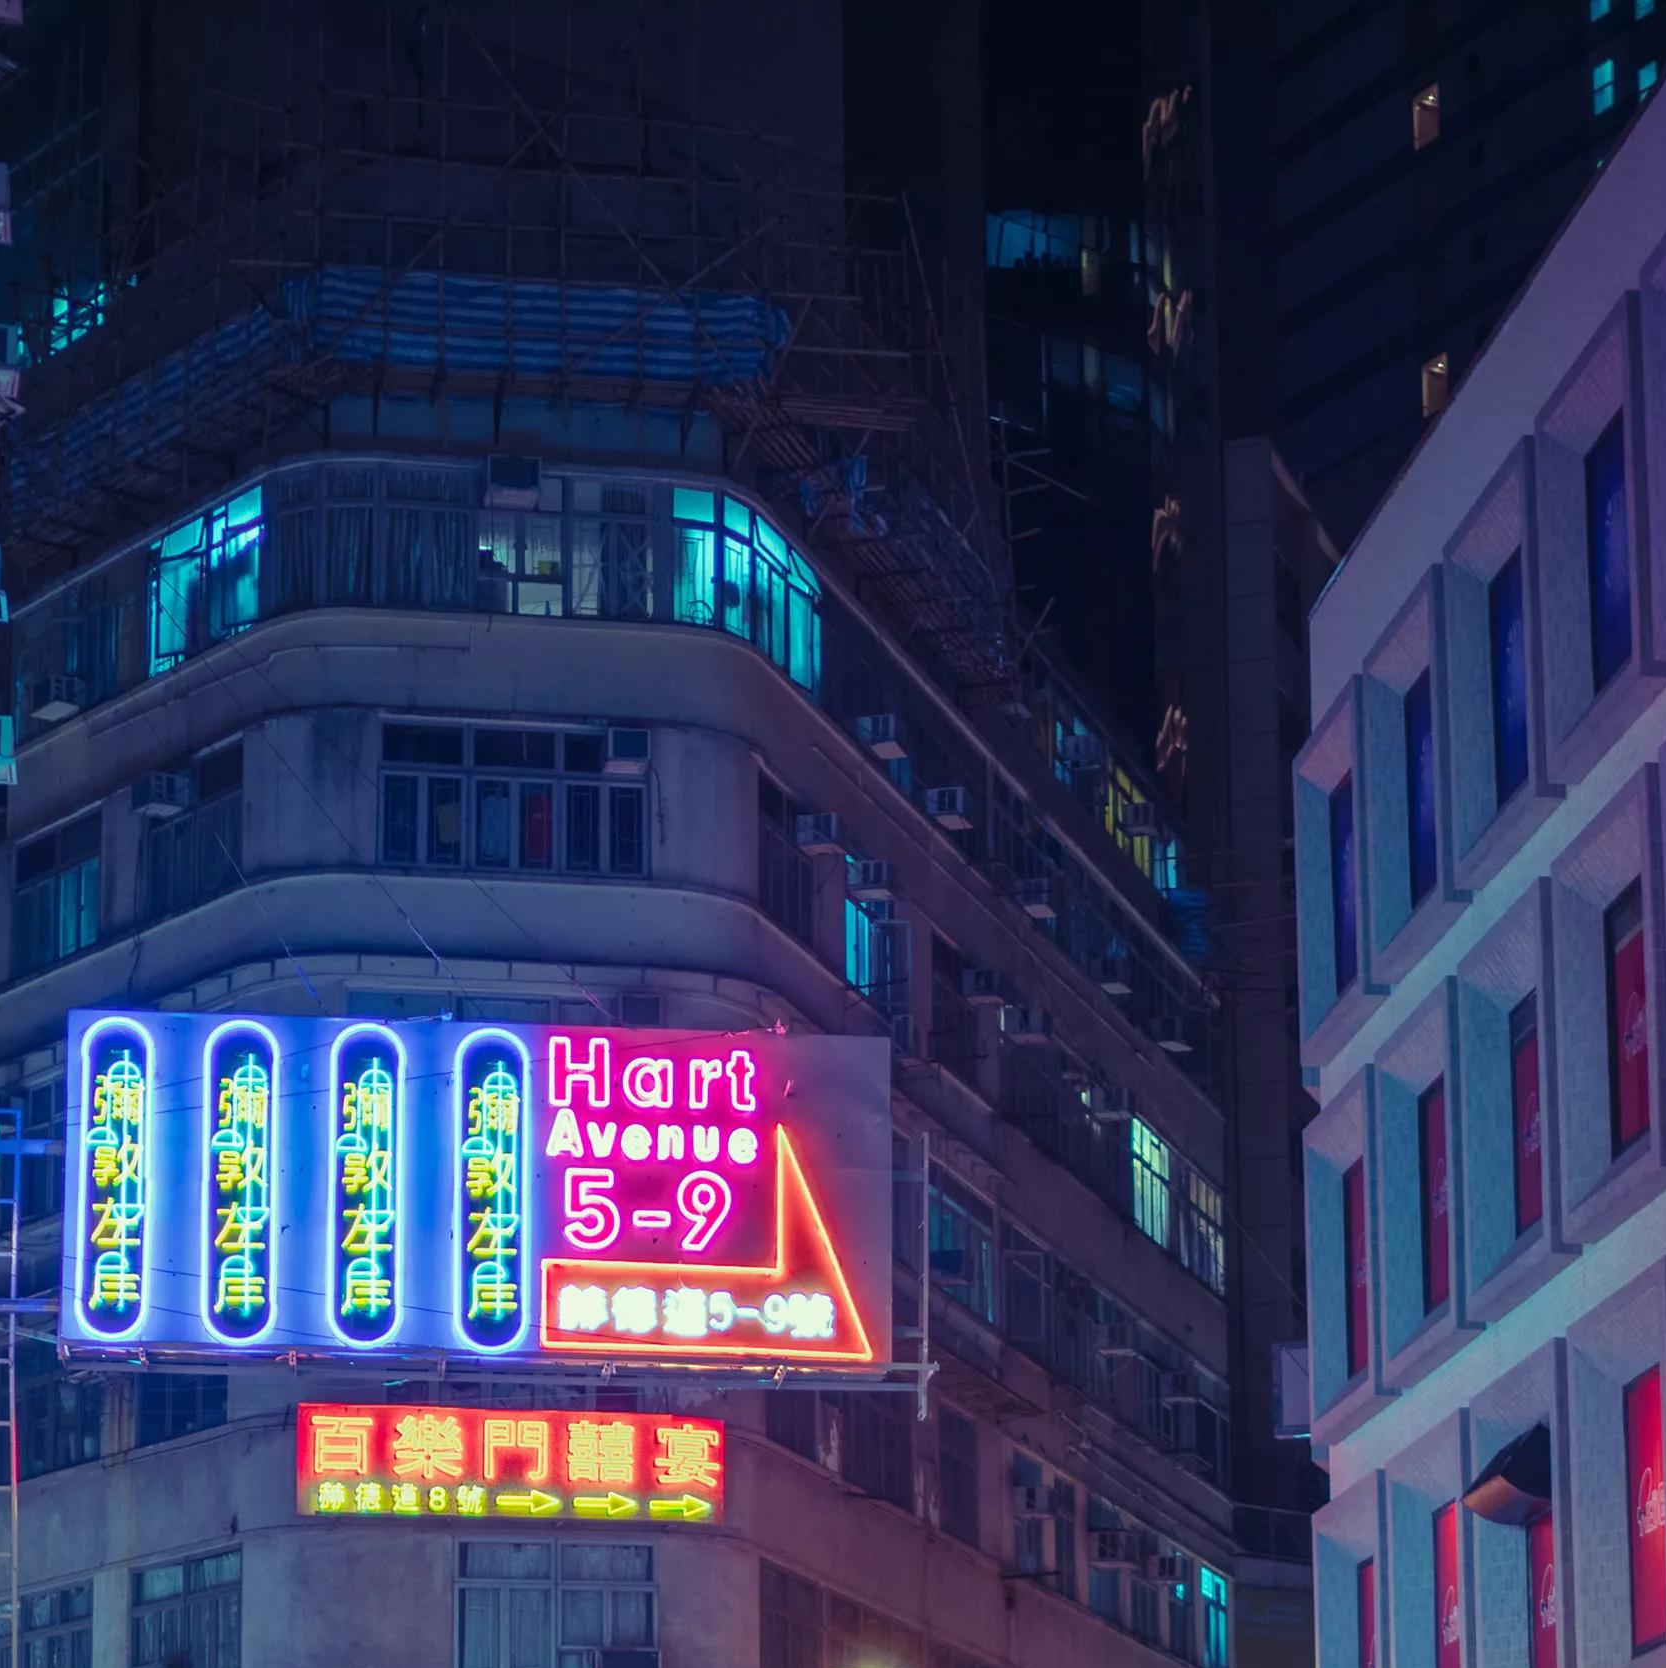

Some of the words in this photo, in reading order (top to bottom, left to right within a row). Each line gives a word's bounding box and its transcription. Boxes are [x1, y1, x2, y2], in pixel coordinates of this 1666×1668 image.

[548, 1036, 757, 1114] Hart
[546, 1109, 759, 1165] Avenue
[562, 1168, 734, 1251] 5-9
[312, 1415, 721, 1487] 百樂門囍宴
